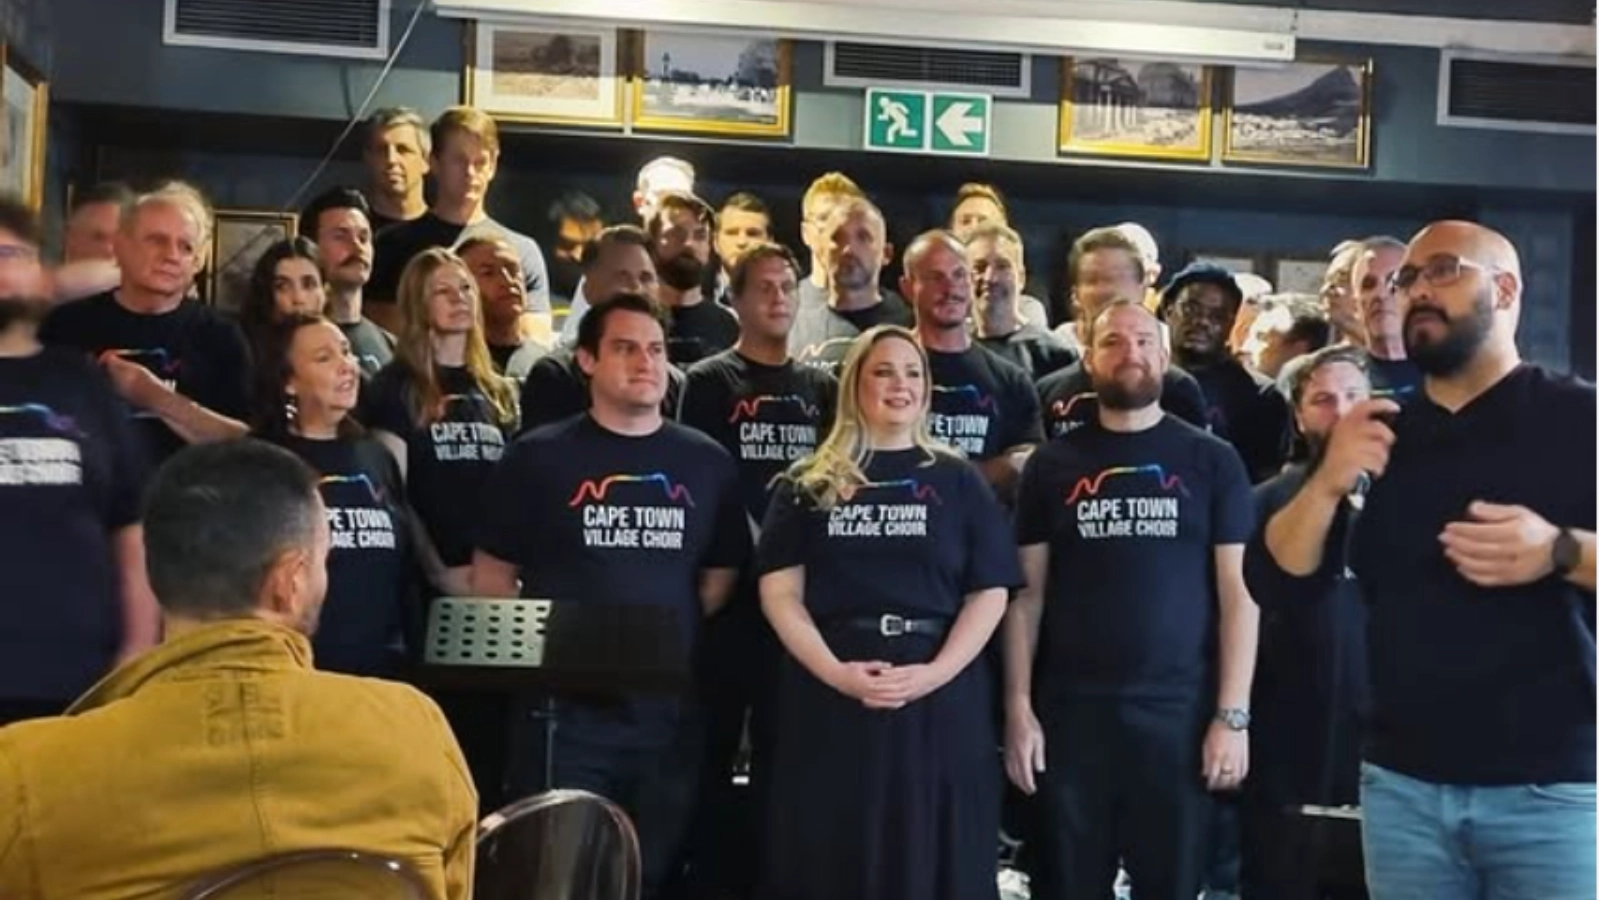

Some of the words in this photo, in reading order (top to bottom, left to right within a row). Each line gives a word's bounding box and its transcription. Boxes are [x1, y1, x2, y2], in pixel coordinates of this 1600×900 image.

[740, 422, 776, 443] CAPE
[777, 423, 817, 444] TOWN
[740, 444, 785, 460] VILLAGE
[344, 508, 393, 531] TOWN
[583, 504, 629, 528] CAPE
[633, 506, 685, 530] TOWN
[829, 504, 874, 521] CAPE
[877, 504, 927, 521] TOWN
[1077, 498, 1122, 521] CAPE
[1126, 497, 1178, 519] TOWN
[583, 528, 640, 548] VILLAGE
[641, 530, 683, 549] CHOIR
[827, 521, 881, 537] VILLAGE
[884, 521, 927, 537] CHOIR
[1077, 520, 1133, 538] VILLAGE
[1135, 520, 1178, 537] CHOIR
